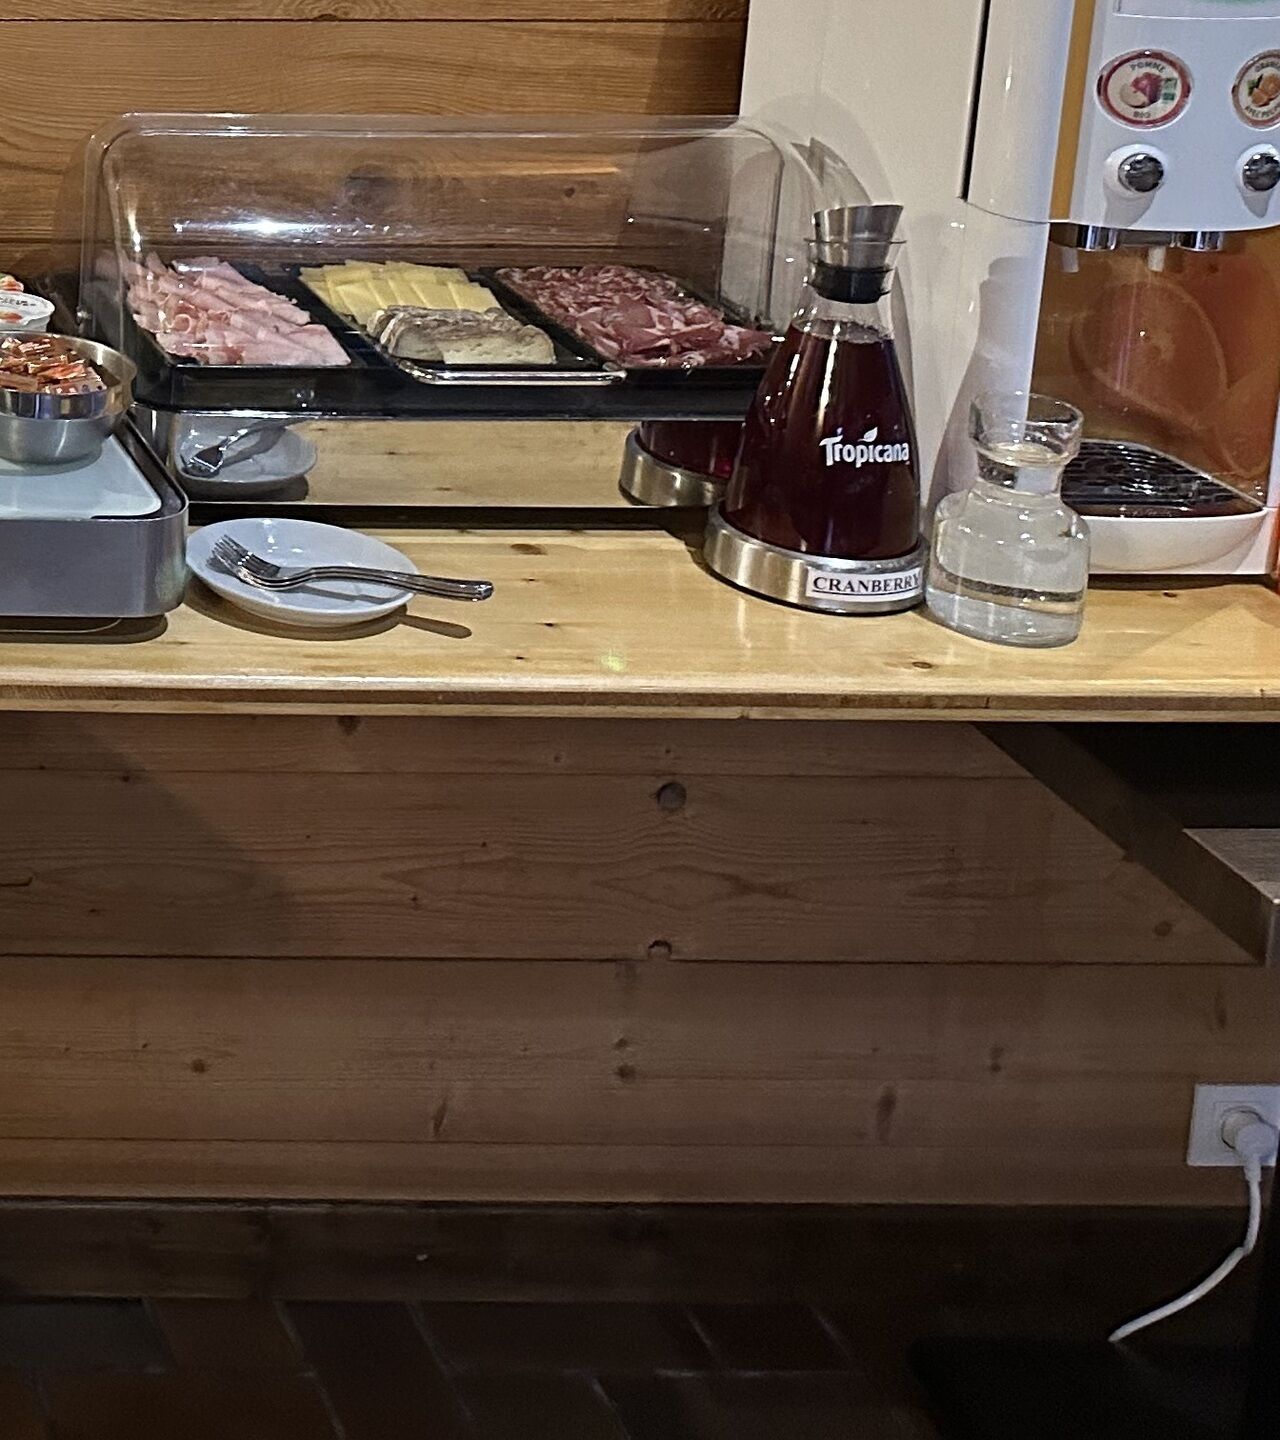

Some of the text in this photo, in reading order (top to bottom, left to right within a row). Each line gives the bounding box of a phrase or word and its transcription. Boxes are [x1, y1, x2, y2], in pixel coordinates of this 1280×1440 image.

[1129, 60, 1167, 74] POMME
[819, 429, 910, 468] Tropicana
[813, 571, 922, 594] CRANBERRY
